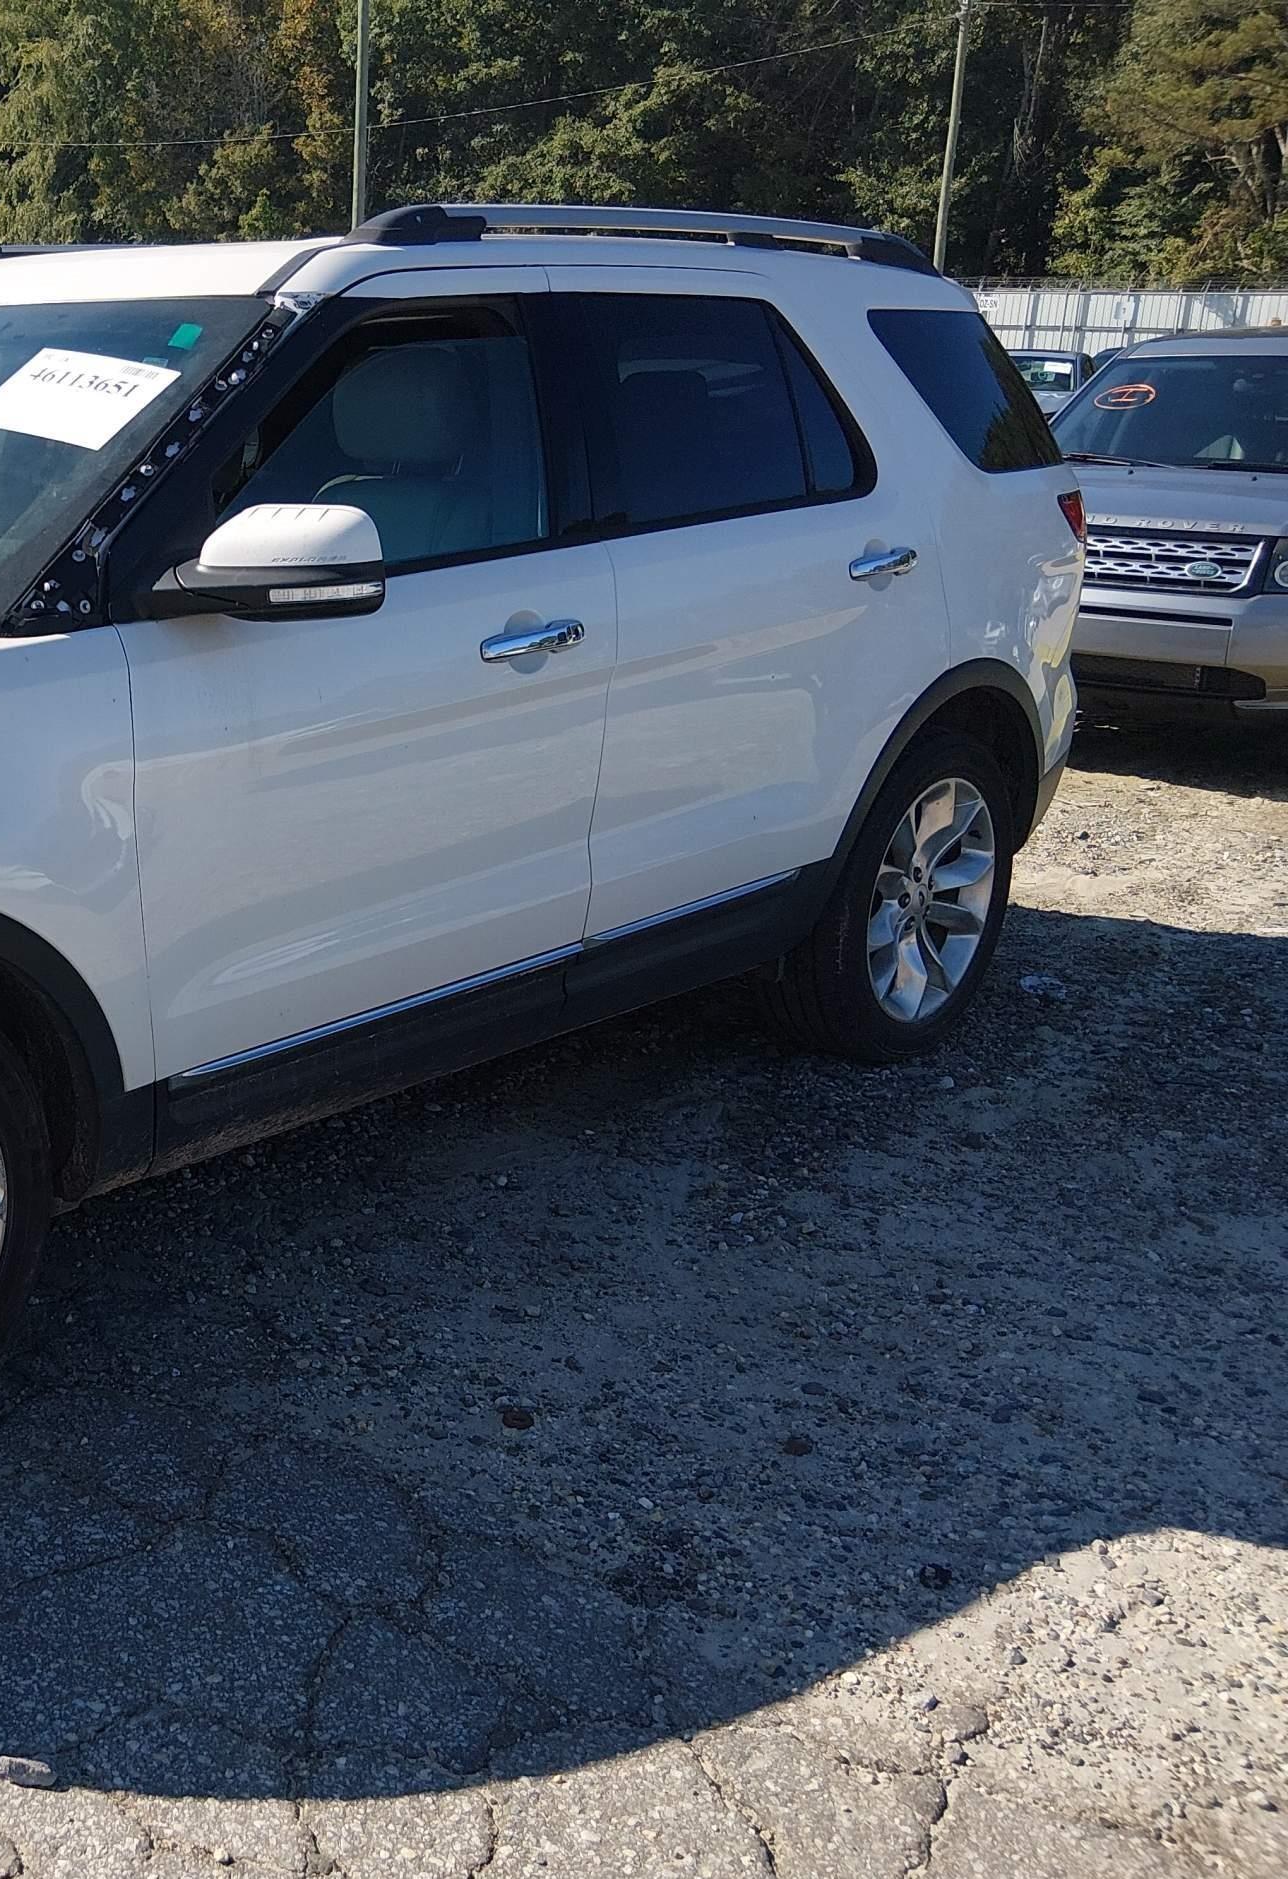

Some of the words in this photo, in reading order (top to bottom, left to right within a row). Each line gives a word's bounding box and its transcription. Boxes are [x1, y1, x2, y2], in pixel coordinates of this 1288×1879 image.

[30, 367, 140, 397] 46113651
[1086, 513, 1119, 525] ND
[1134, 518, 1246, 533] ROVER
